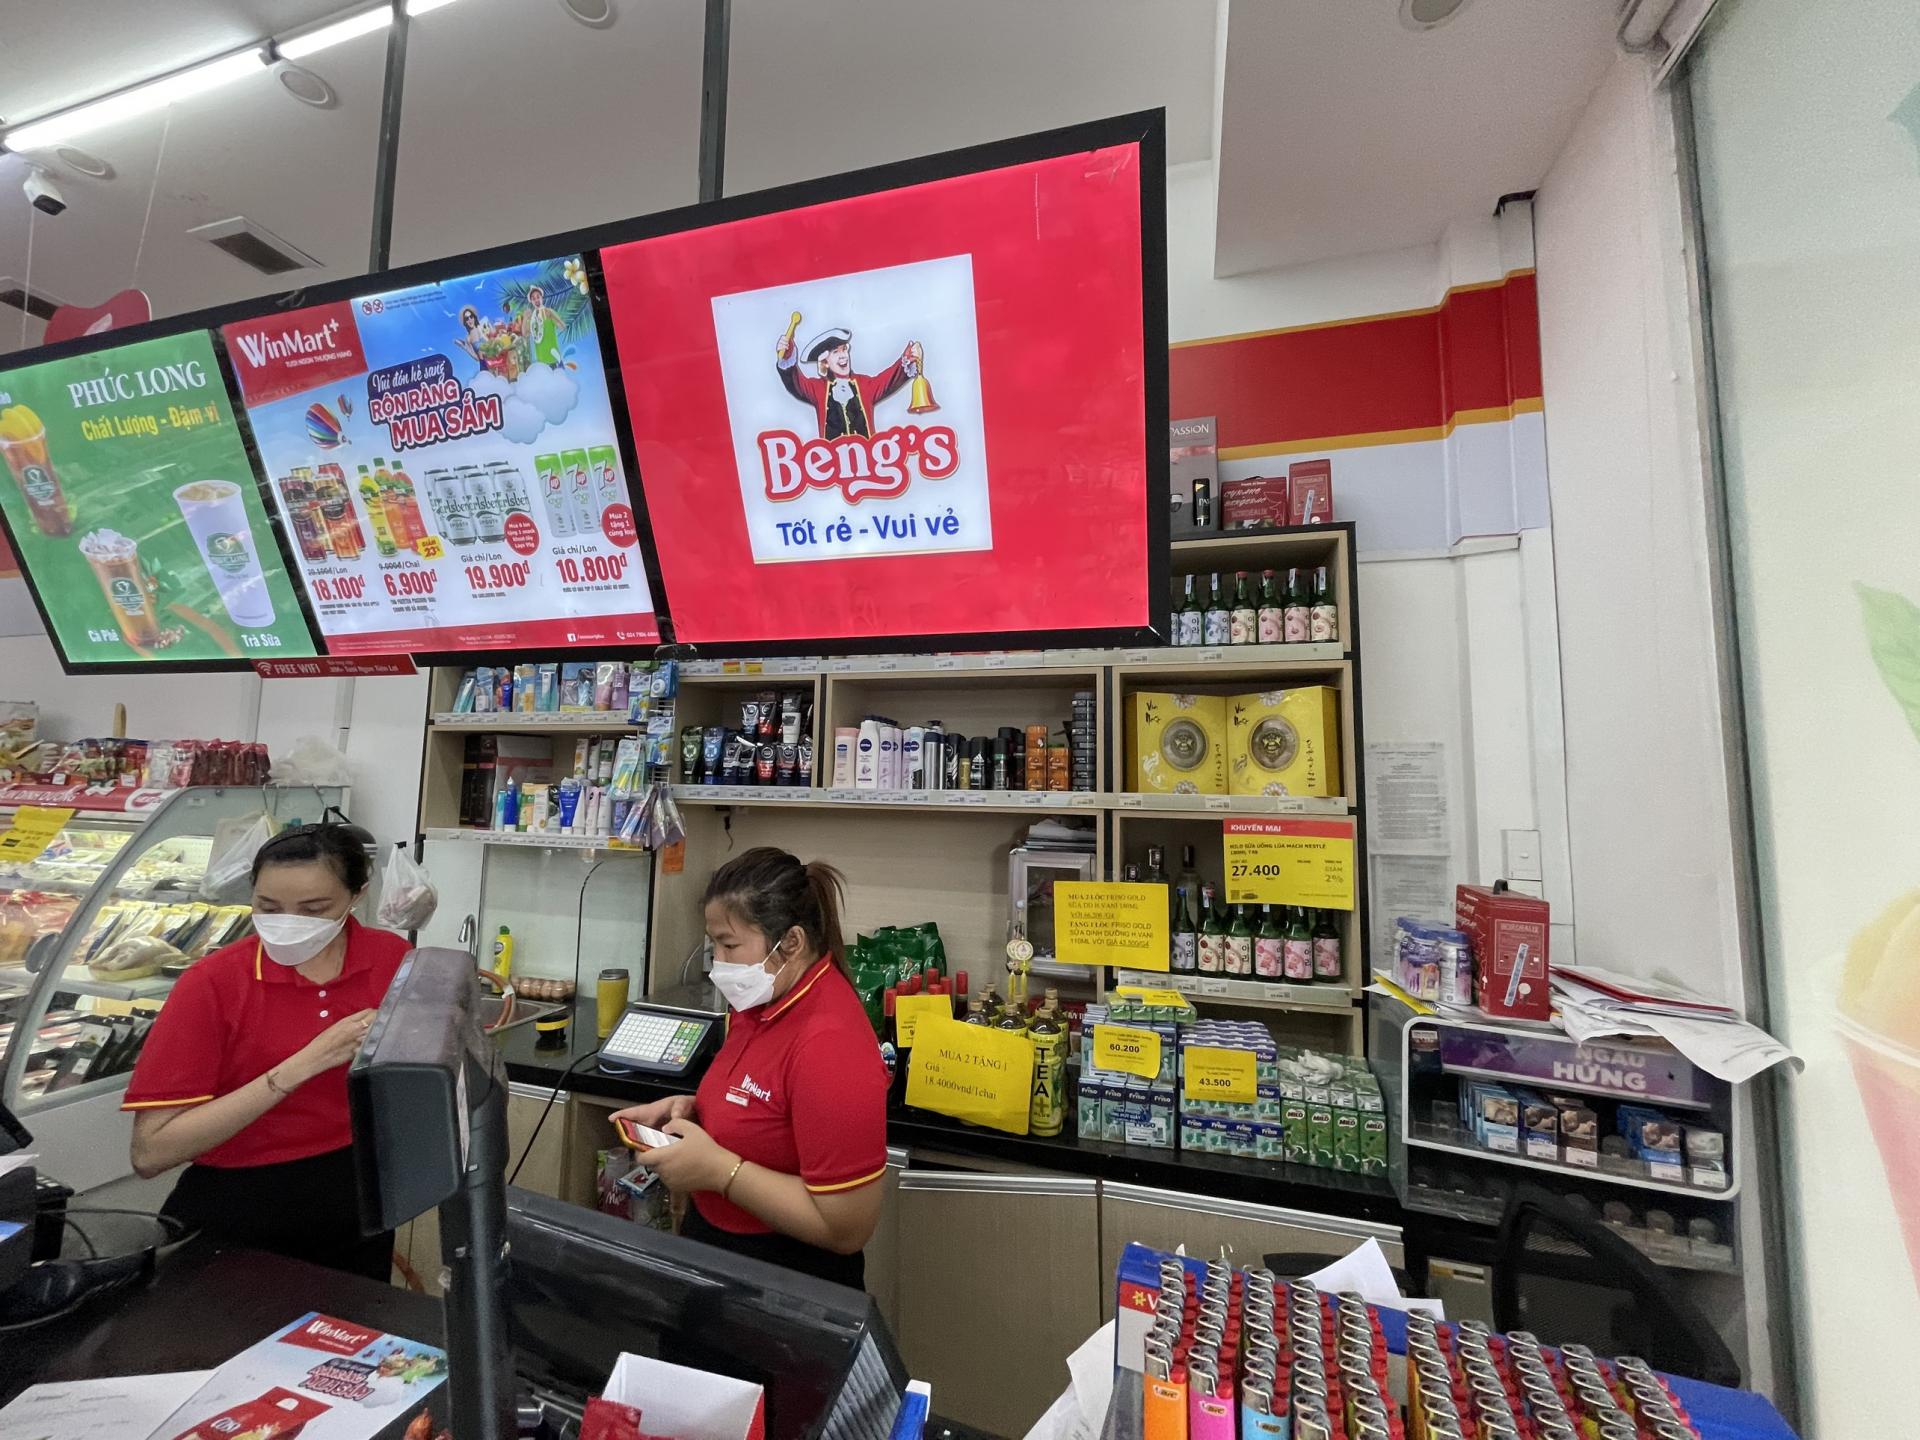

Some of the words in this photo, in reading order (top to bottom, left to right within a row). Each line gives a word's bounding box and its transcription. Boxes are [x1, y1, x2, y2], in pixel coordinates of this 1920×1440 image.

[237, 319, 339, 368] WinMart+
[67, 368, 134, 408] PHÚC
[135, 361, 207, 397] LONG
[372, 373, 391, 393] Vui
[411, 364, 423, 382] hè
[370, 392, 408, 422] RỘN
[408, 379, 460, 413] RÀNG
[81, 415, 113, 441] Chất
[115, 414, 159, 438] Lượng
[167, 405, 203, 431] Đậm
[204, 400, 221, 426] vị
[390, 412, 445, 449] MUA
[444, 391, 500, 436] SẮM
[763, 433, 951, 496] Beng's
[776, 518, 817, 547] Tốt
[826, 515, 851, 543] rẻ
[872, 513, 917, 540] Vui
[925, 507, 960, 537] vẻ
[465, 560, 530, 590] 19.900đ
[556, 552, 628, 584] 10.800đ
[274, 664, 299, 675] FREE
[298, 663, 321, 674] WIFI
[1231, 864, 1281, 877] 27.400
[939, 1049, 963, 1063] MUA
[965, 1056, 970, 1064] 2
[1109, 1043, 1140, 1053] 60.200
[1199, 1078, 1231, 1087] 43.500
